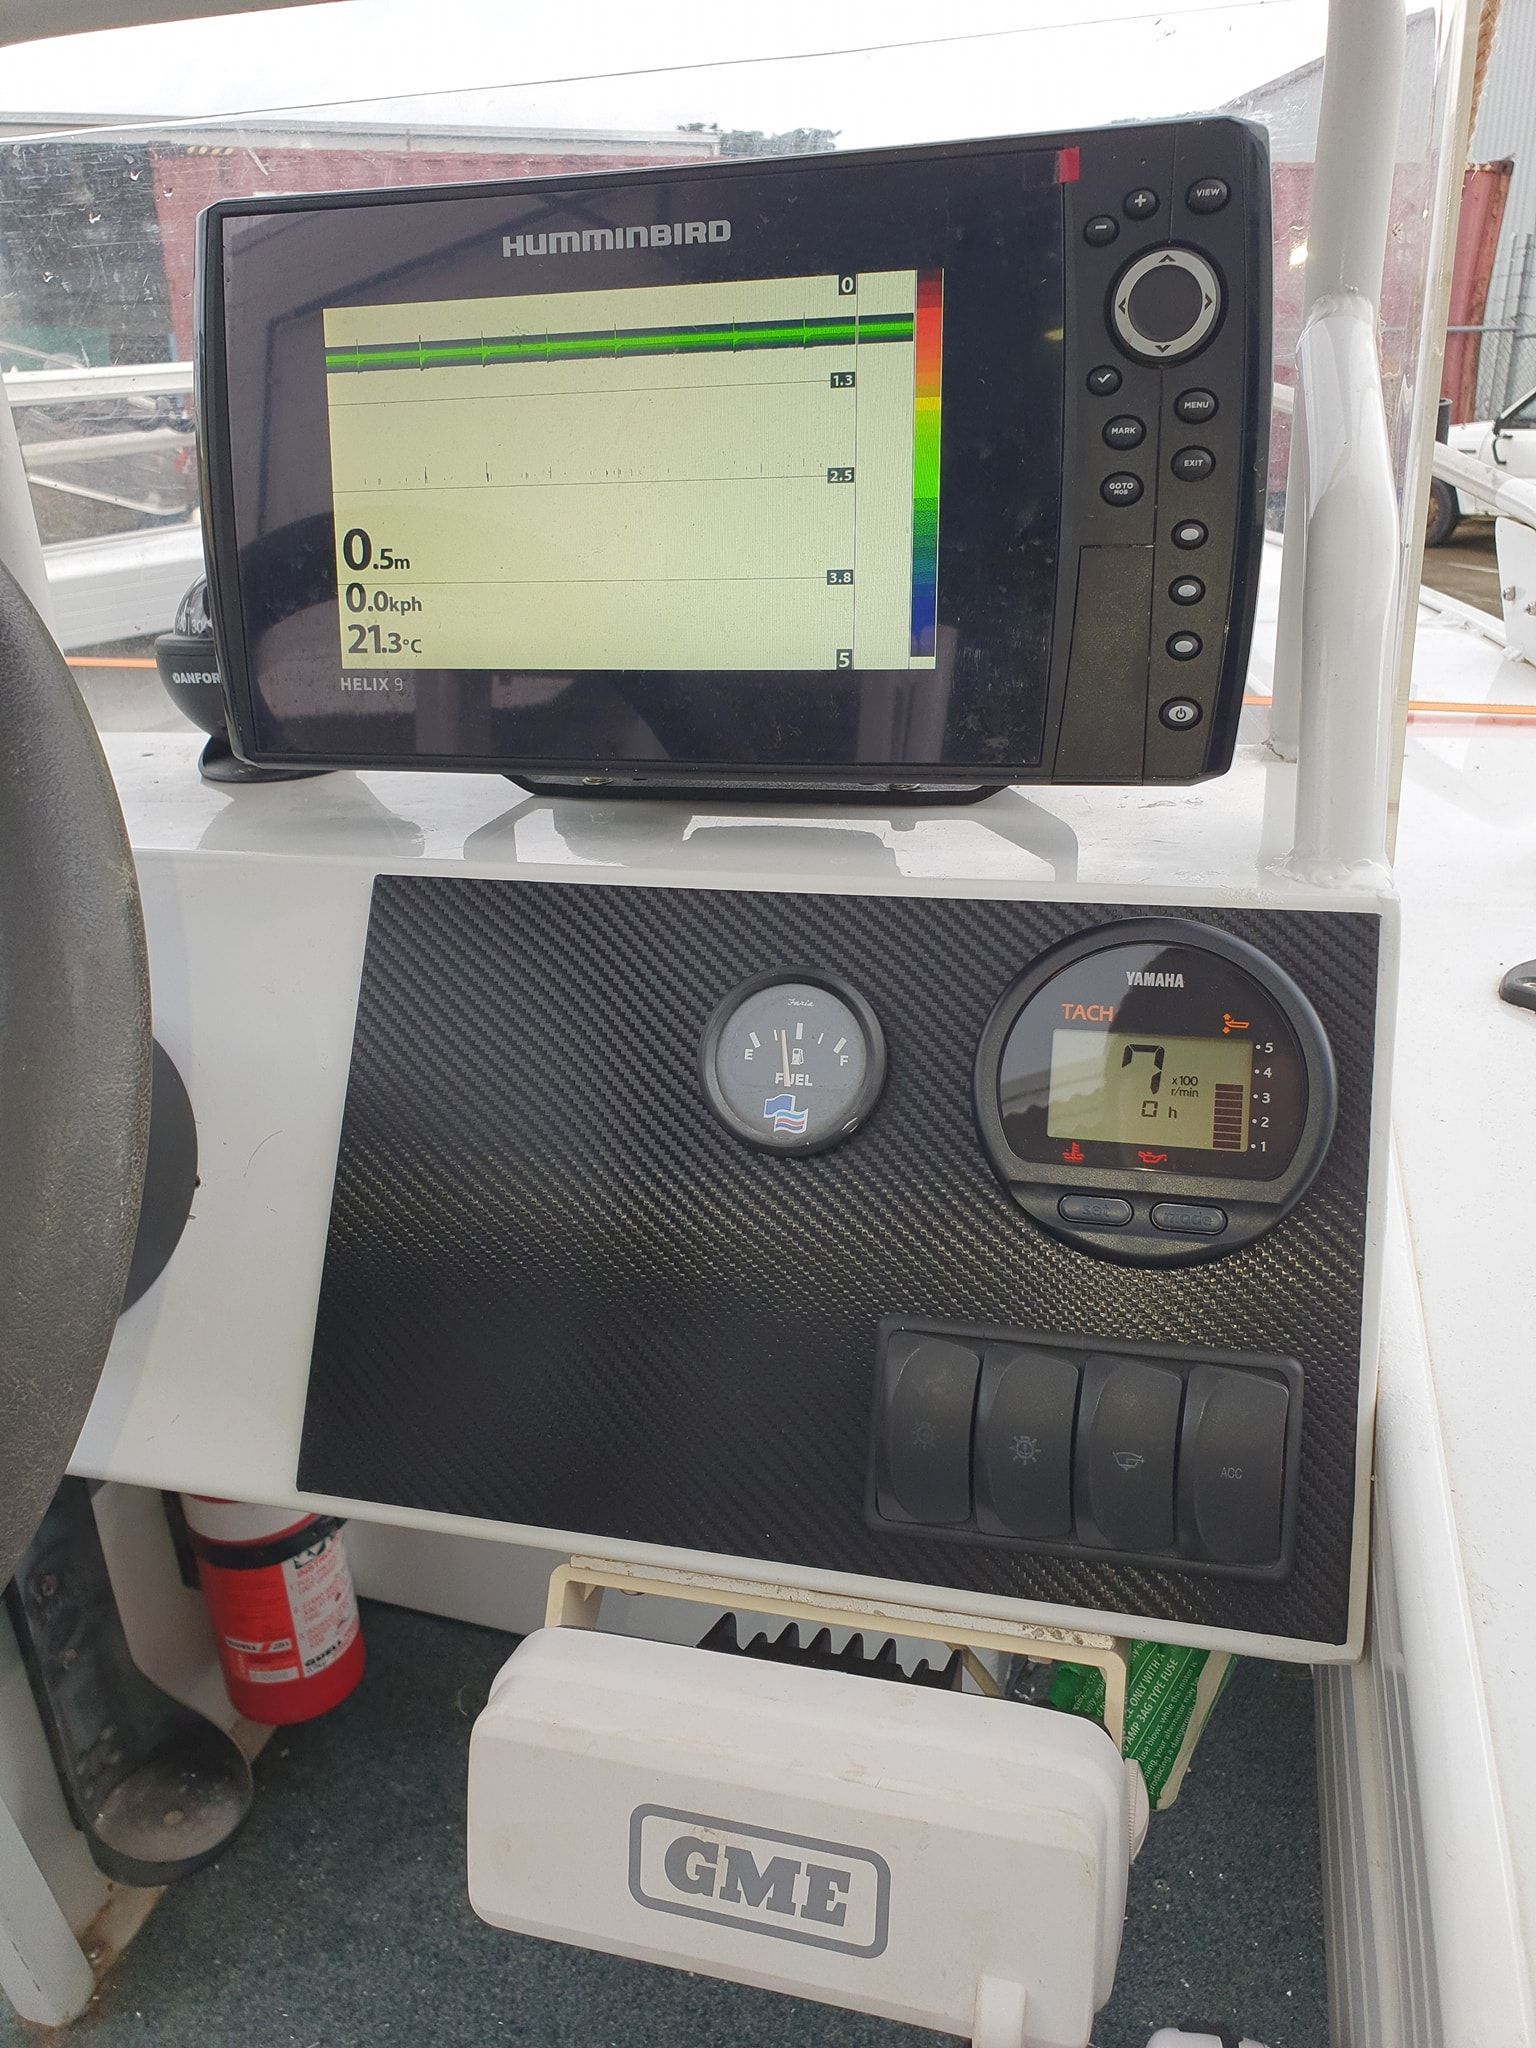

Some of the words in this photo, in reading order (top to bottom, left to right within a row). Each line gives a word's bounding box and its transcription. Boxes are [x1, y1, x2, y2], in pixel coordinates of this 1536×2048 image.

[1196, 187, 1221, 198] VIEW
[502, 219, 732, 258] HUMMINBIRD
[840, 277, 854, 293] 0
[832, 374, 853, 387] 1.3
[1184, 401, 1209, 409] MENU
[1111, 427, 1136, 435] MARK
[1184, 459, 1204, 467] EXIT
[829, 470, 852, 482] 2.5
[829, 572, 852, 584] 3.8
[838, 652, 850, 668] 5
[172, 672, 221, 684] DANFOR
[340, 677, 389, 692] HELIX
[394, 677, 404, 692] 9
[1126, 972, 1184, 988] YAMAHA
[1061, 1003, 1114, 1022] TACH
[1265, 1042, 1274, 1053] 5
[744, 1048, 754, 1061] E
[839, 1055, 849, 1067] F
[1121, 1043, 1165, 1095] 7
[1263, 1067, 1272, 1078] 4
[1170, 1086, 1199, 1098] r/min
[1262, 1093, 1271, 1104] 3
[1168, 1106, 1178, 1119] h
[1261, 1117, 1270, 1128] 2
[1260, 1141, 1267, 1152] 1
[1082, 1204, 1111, 1218] set
[1164, 1210, 1214, 1228] mode
[1220, 1467, 1242, 1479] ACC
[1127, 1681, 1148, 1707] ONLY
[1140, 1658, 1161, 1684] WITH
[1122, 1720, 1142, 1745] AMP
[1135, 1701, 1153, 1723] 3AG
[1146, 1679, 1167, 1703] TYPE
[1158, 1656, 1179, 1682] FUSE
[1143, 1721, 1164, 1747] blows
[1156, 1700, 1175, 1724] while
[1168, 1687, 1182, 1703] the
[1152, 1739, 1169, 1759] your
[1162, 1702, 1186, 1740] alternator
[664, 1835, 851, 1927] GME
